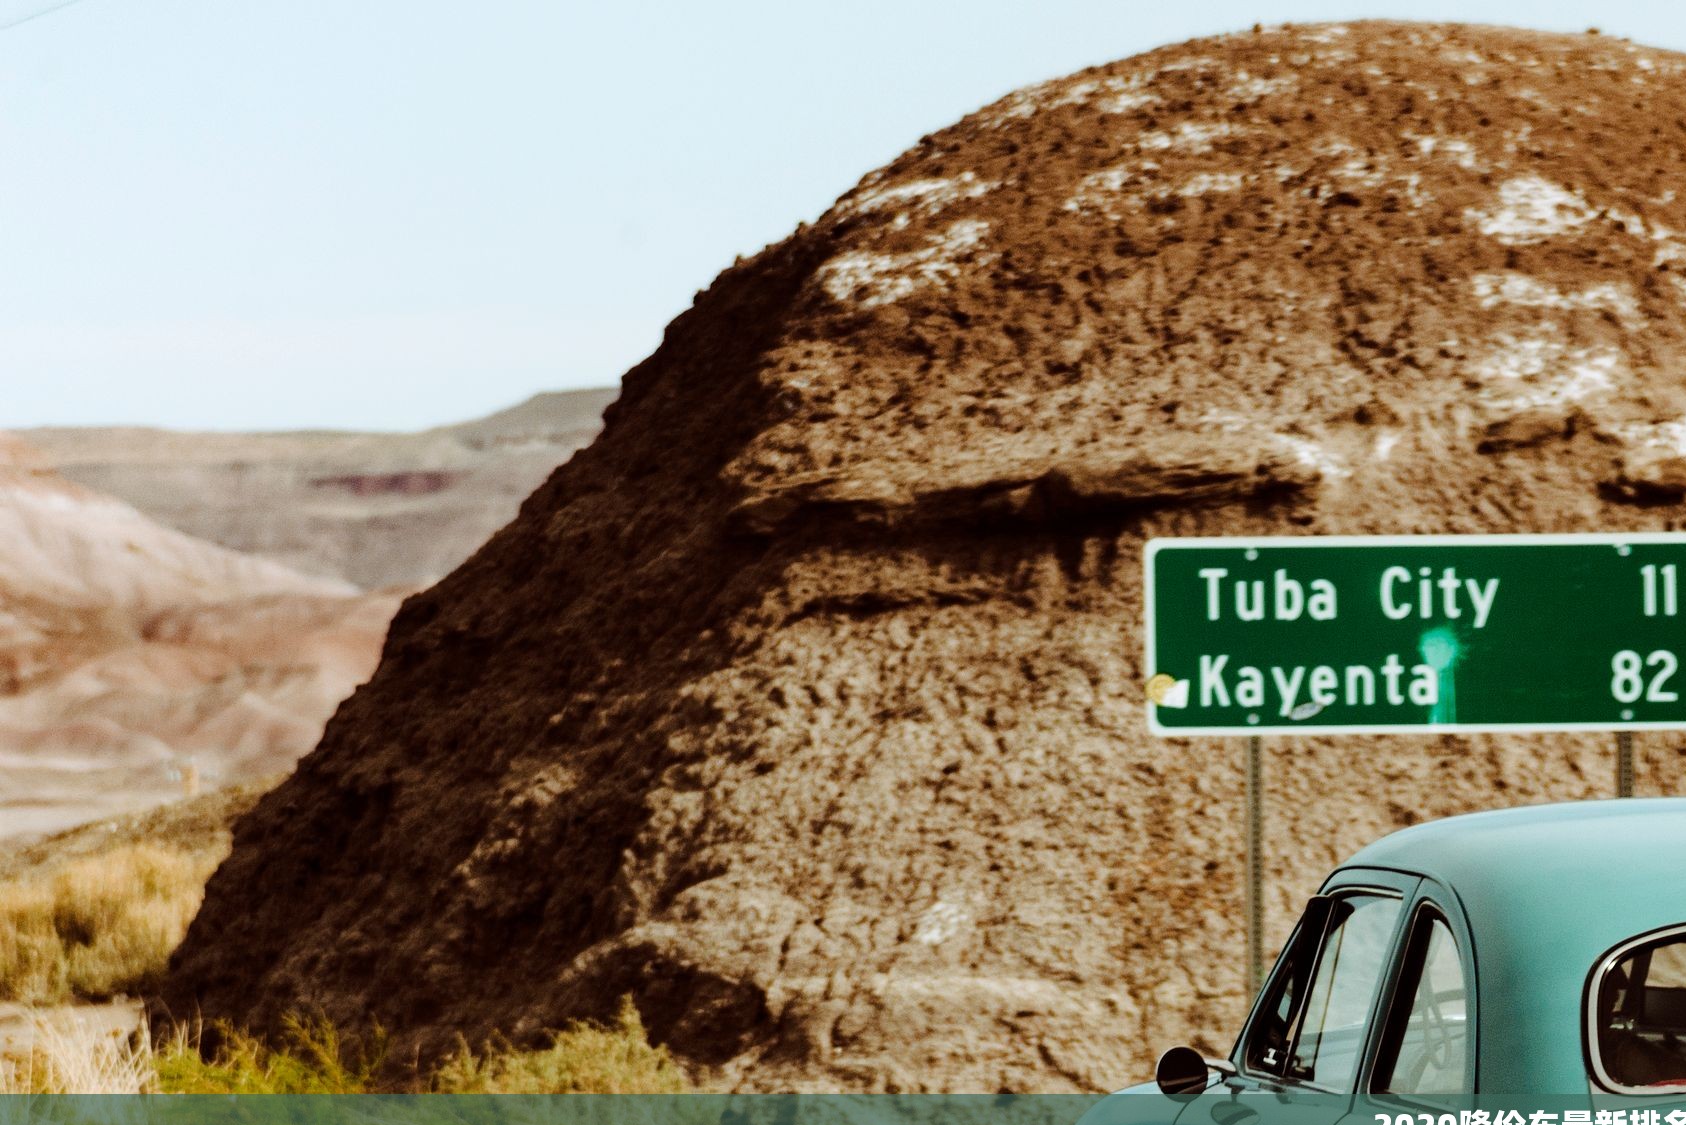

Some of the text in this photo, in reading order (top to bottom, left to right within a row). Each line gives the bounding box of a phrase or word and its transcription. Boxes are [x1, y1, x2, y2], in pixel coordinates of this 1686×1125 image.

[1199, 564, 1678, 628] Tuba City 11
[1200, 650, 1678, 716] Kayenta 82
